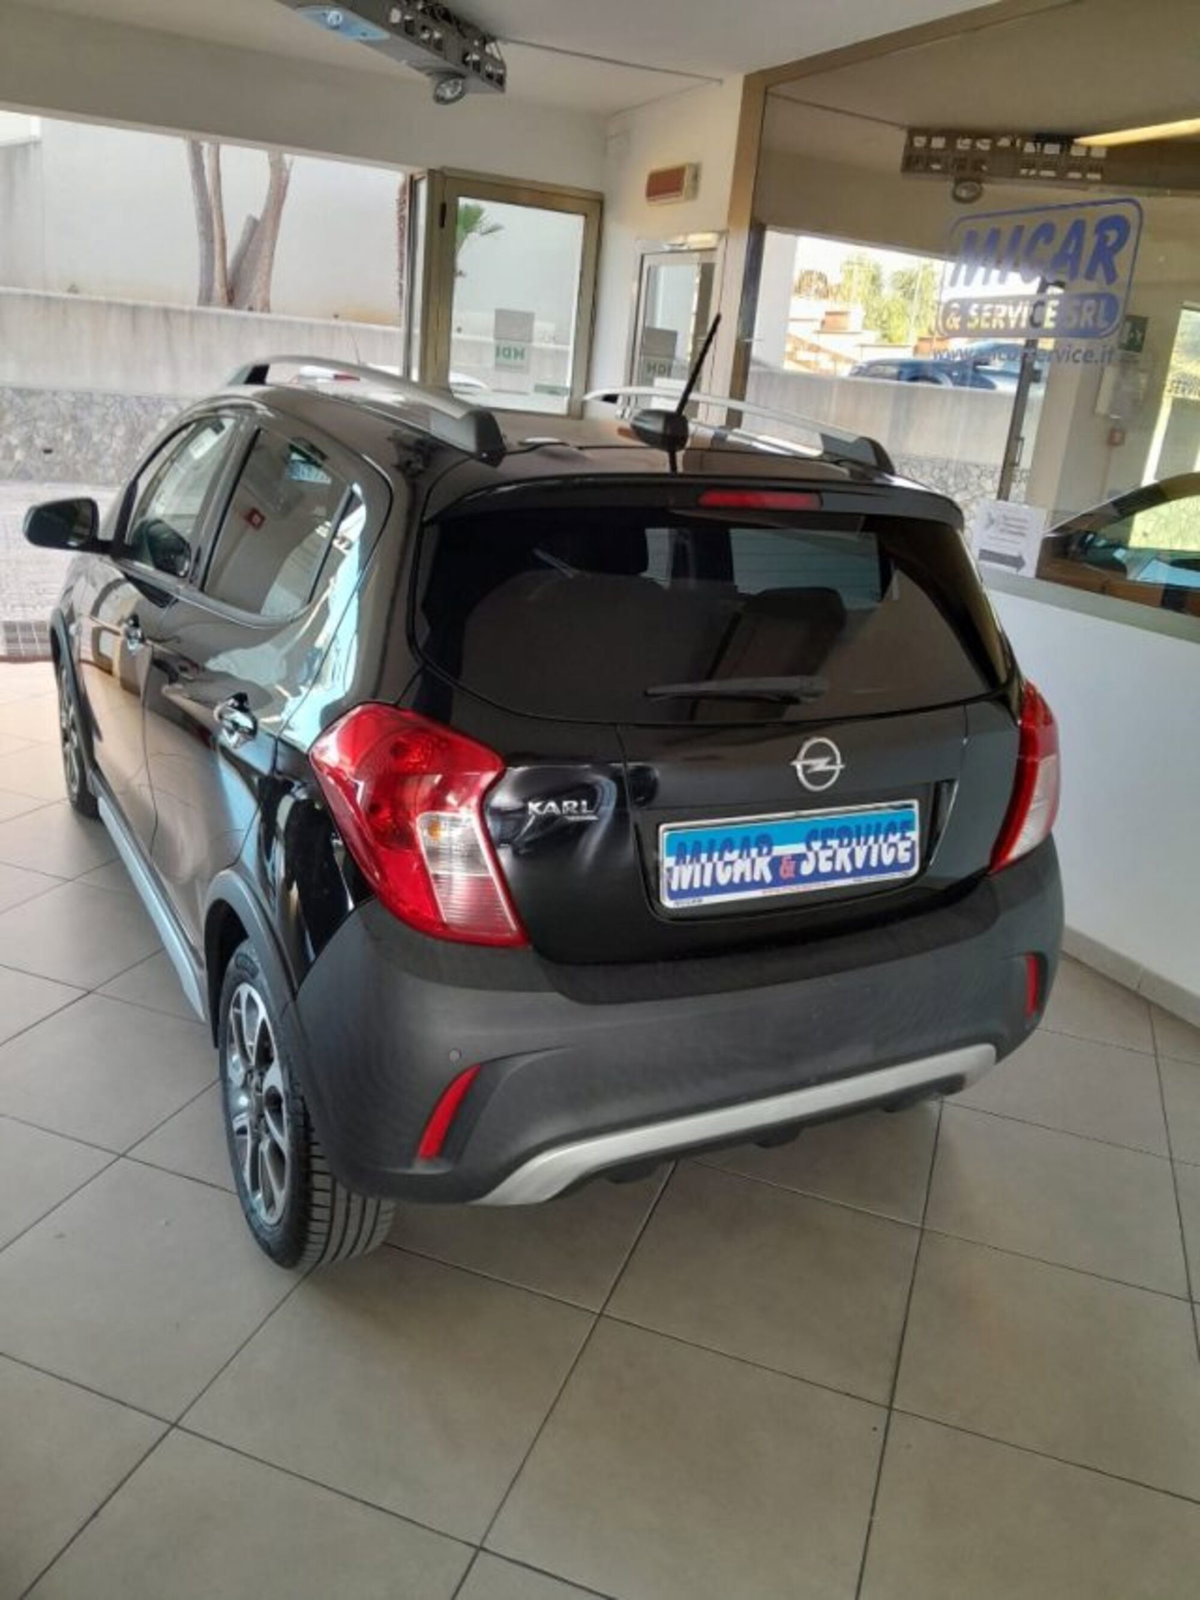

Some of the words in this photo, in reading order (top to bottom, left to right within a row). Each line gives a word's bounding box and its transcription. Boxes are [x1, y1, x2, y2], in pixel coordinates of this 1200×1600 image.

[950, 214, 1130, 287] MICAR
[946, 302, 961, 331] &
[967, 301, 1060, 330] SERVICE
[1066, 299, 1113, 328] SRL
[528, 800, 594, 816] KARL
[671, 834, 774, 891] MICAR
[779, 855, 796, 879] &
[801, 820, 913, 876] SERVICE
